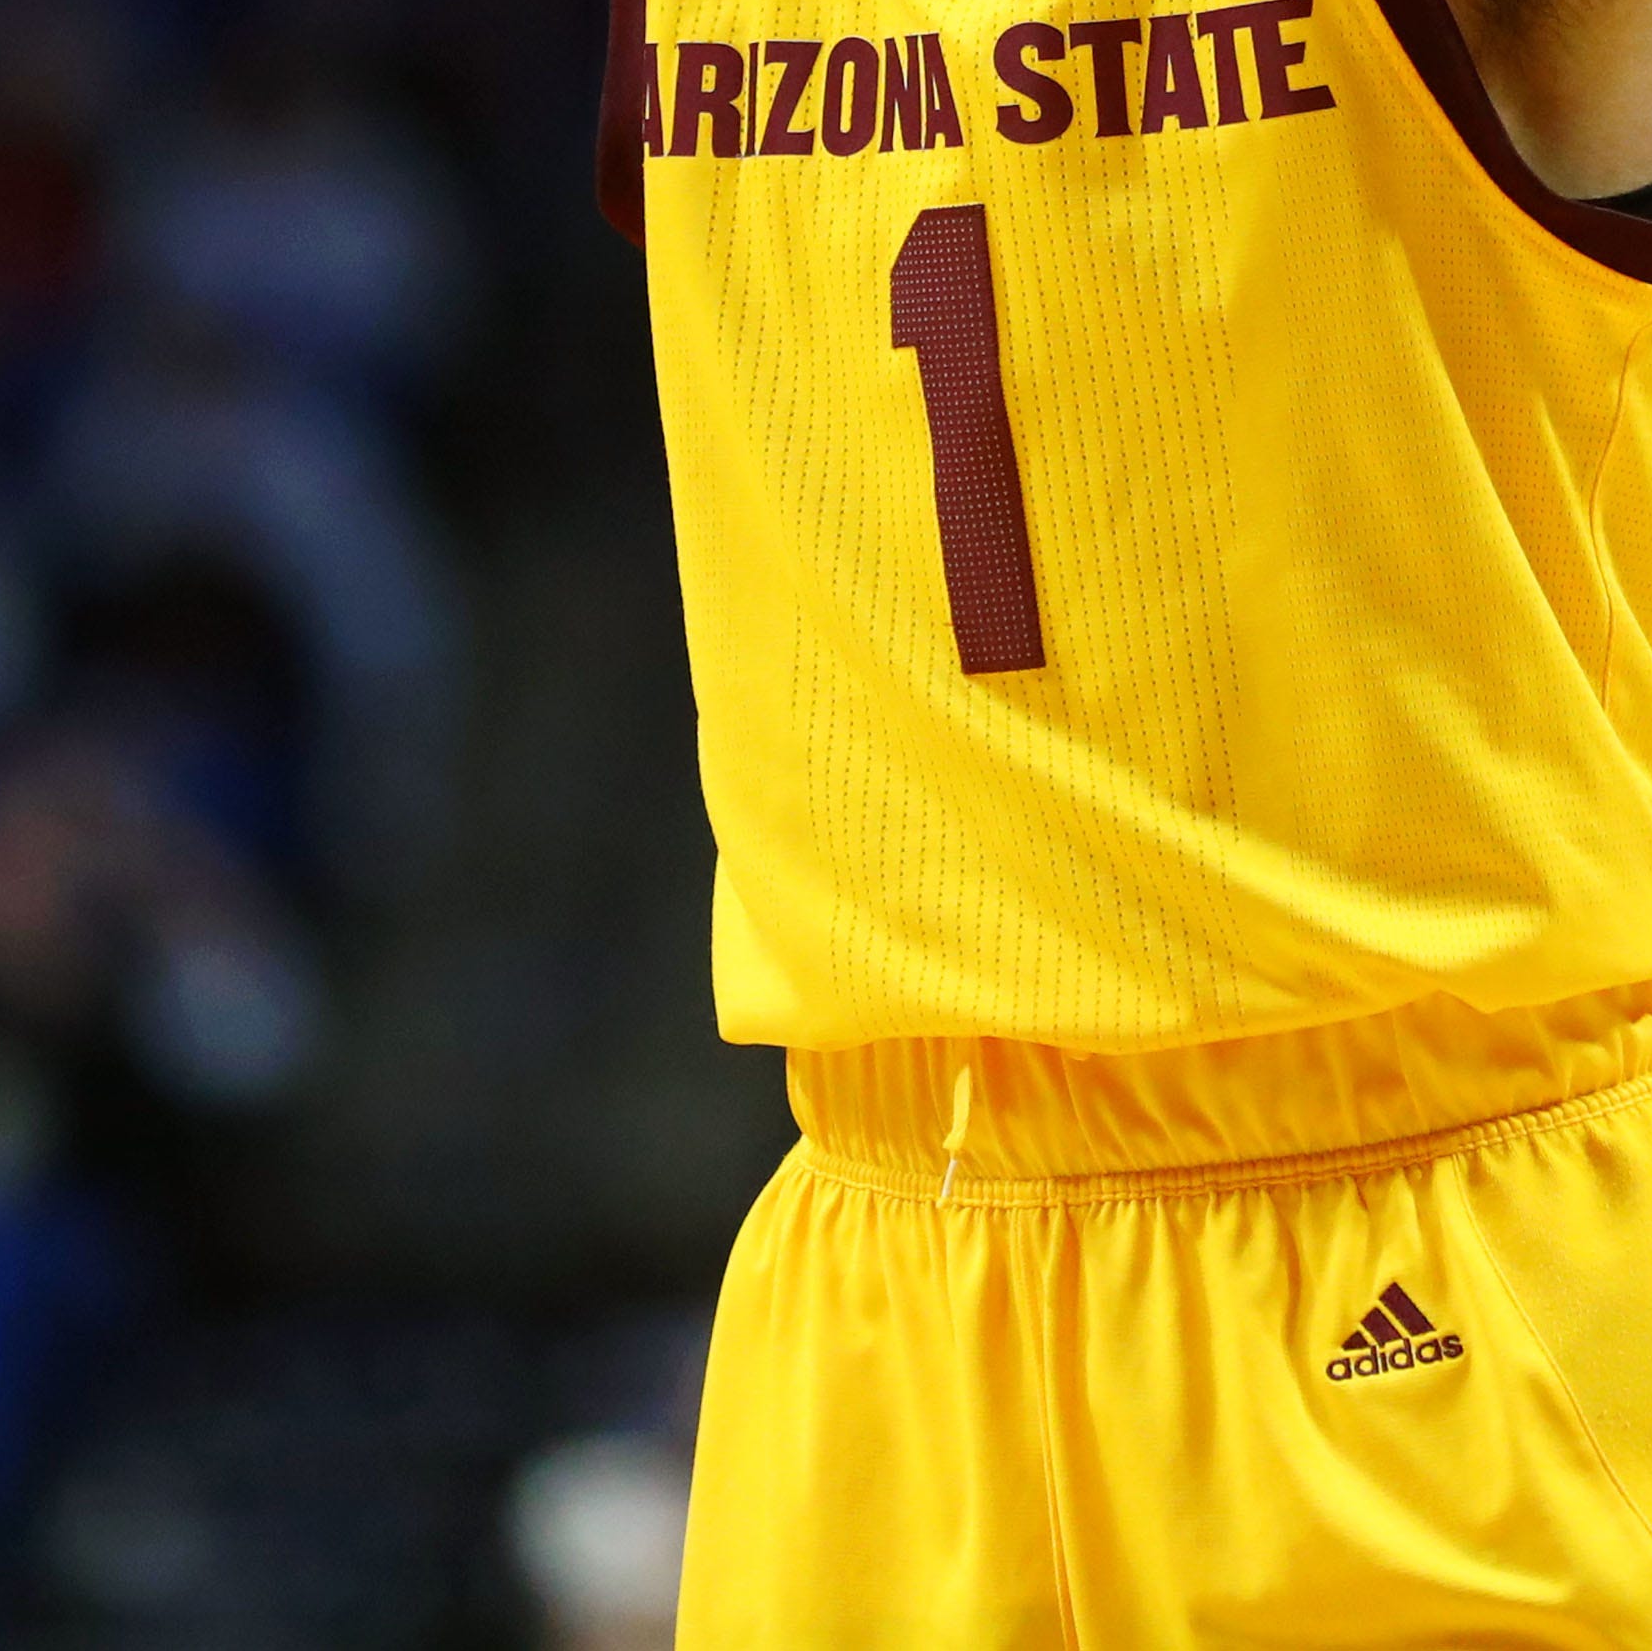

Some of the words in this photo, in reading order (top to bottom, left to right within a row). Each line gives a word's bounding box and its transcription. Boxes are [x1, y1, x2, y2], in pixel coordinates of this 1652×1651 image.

[643, 35, 964, 159] ARIZONA
[889, 203, 1048, 677] 1
[1326, 1333, 1464, 1381] adidas
